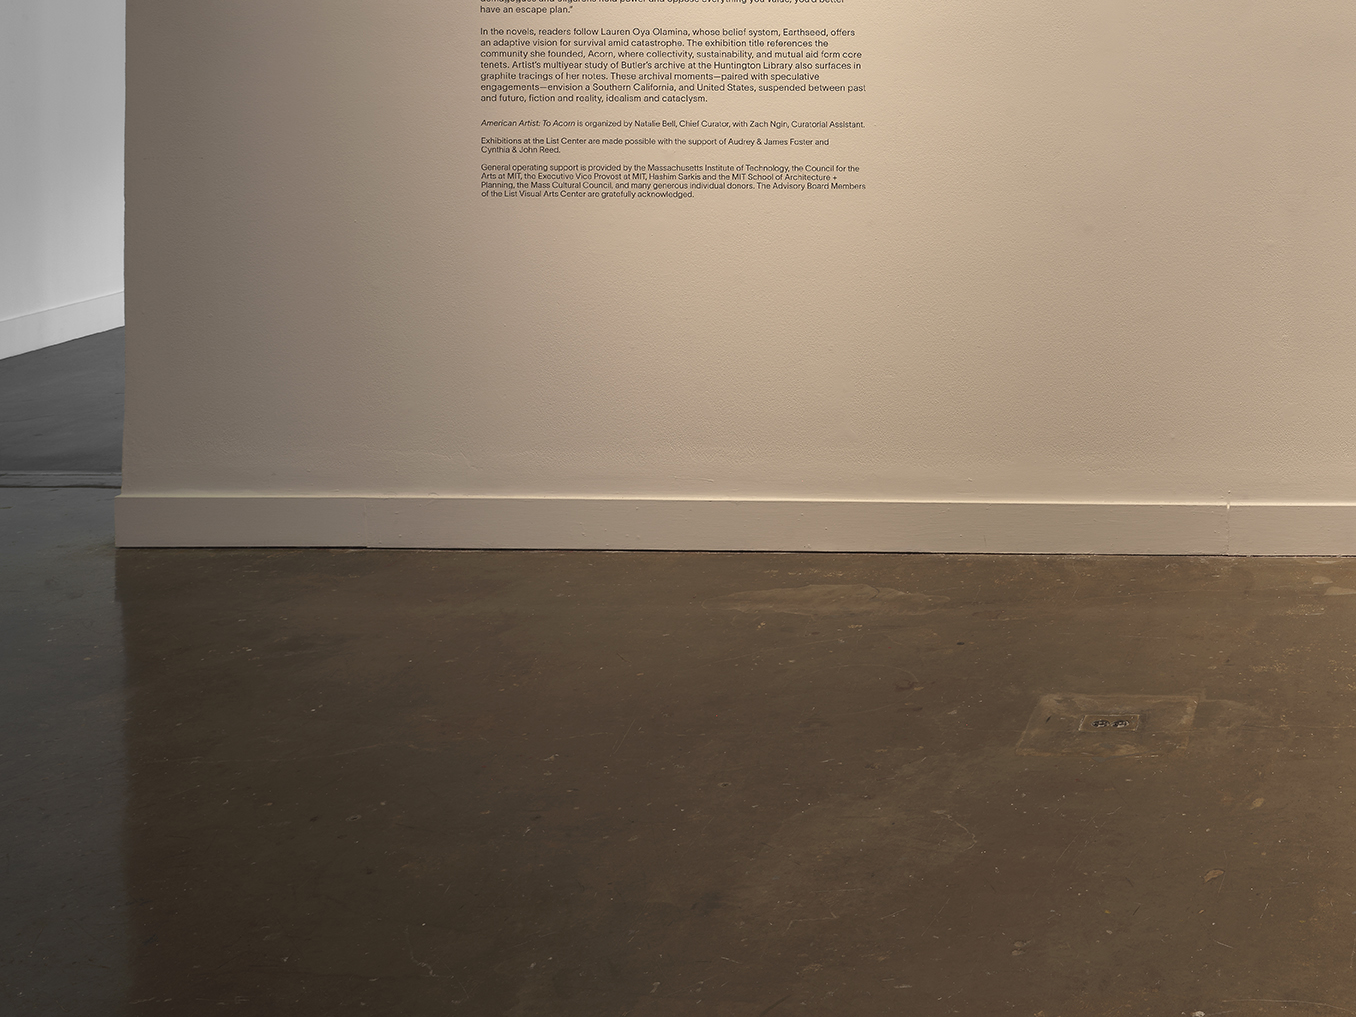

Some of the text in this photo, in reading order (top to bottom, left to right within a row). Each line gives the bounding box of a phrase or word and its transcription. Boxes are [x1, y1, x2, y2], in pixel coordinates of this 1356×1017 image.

[480, 4, 500, 13] have
[516, 6, 547, 15] escape
[493, 38, 530, 49] adaptive
[533, 38, 557, 47] vision
[560, 38, 570, 47] for
[574, 38, 606, 47] survival
[608, 39, 629, 47] amid
[631, 39, 684, 49] catastrophe.
[687, 39, 703, 47] The
[705, 39, 746, 47] exhibition
[749, 39, 764, 47] title
[767, 39, 812, 47] references
[815, 39, 828, 47] the
[481, 93, 707, 104] and future, fiction and reality, idealism and cataclysm.
[585, 120, 621, 129] organized
[624, 120, 632, 129] by
[662, 120, 677, 128] Bell,
[701, 120, 730, 129] Curator,
[770, 120, 789, 130] Ngin,
[791, 120, 827, 128] Curatorial
[829, 120, 865, 128] Assistant.
[481, 146, 510, 155] Cynthia
[512, 164, 548, 173] operating
[550, 164, 578, 173] support
[588, 164, 621, 173] provided
[623, 164, 632, 173] by
[746, 164, 789, 174] Technology,
[792, 164, 803, 172] the
[805, 164, 834, 172] Council
[836, 164, 845, 172] for
[848, 164, 859, 172] the
